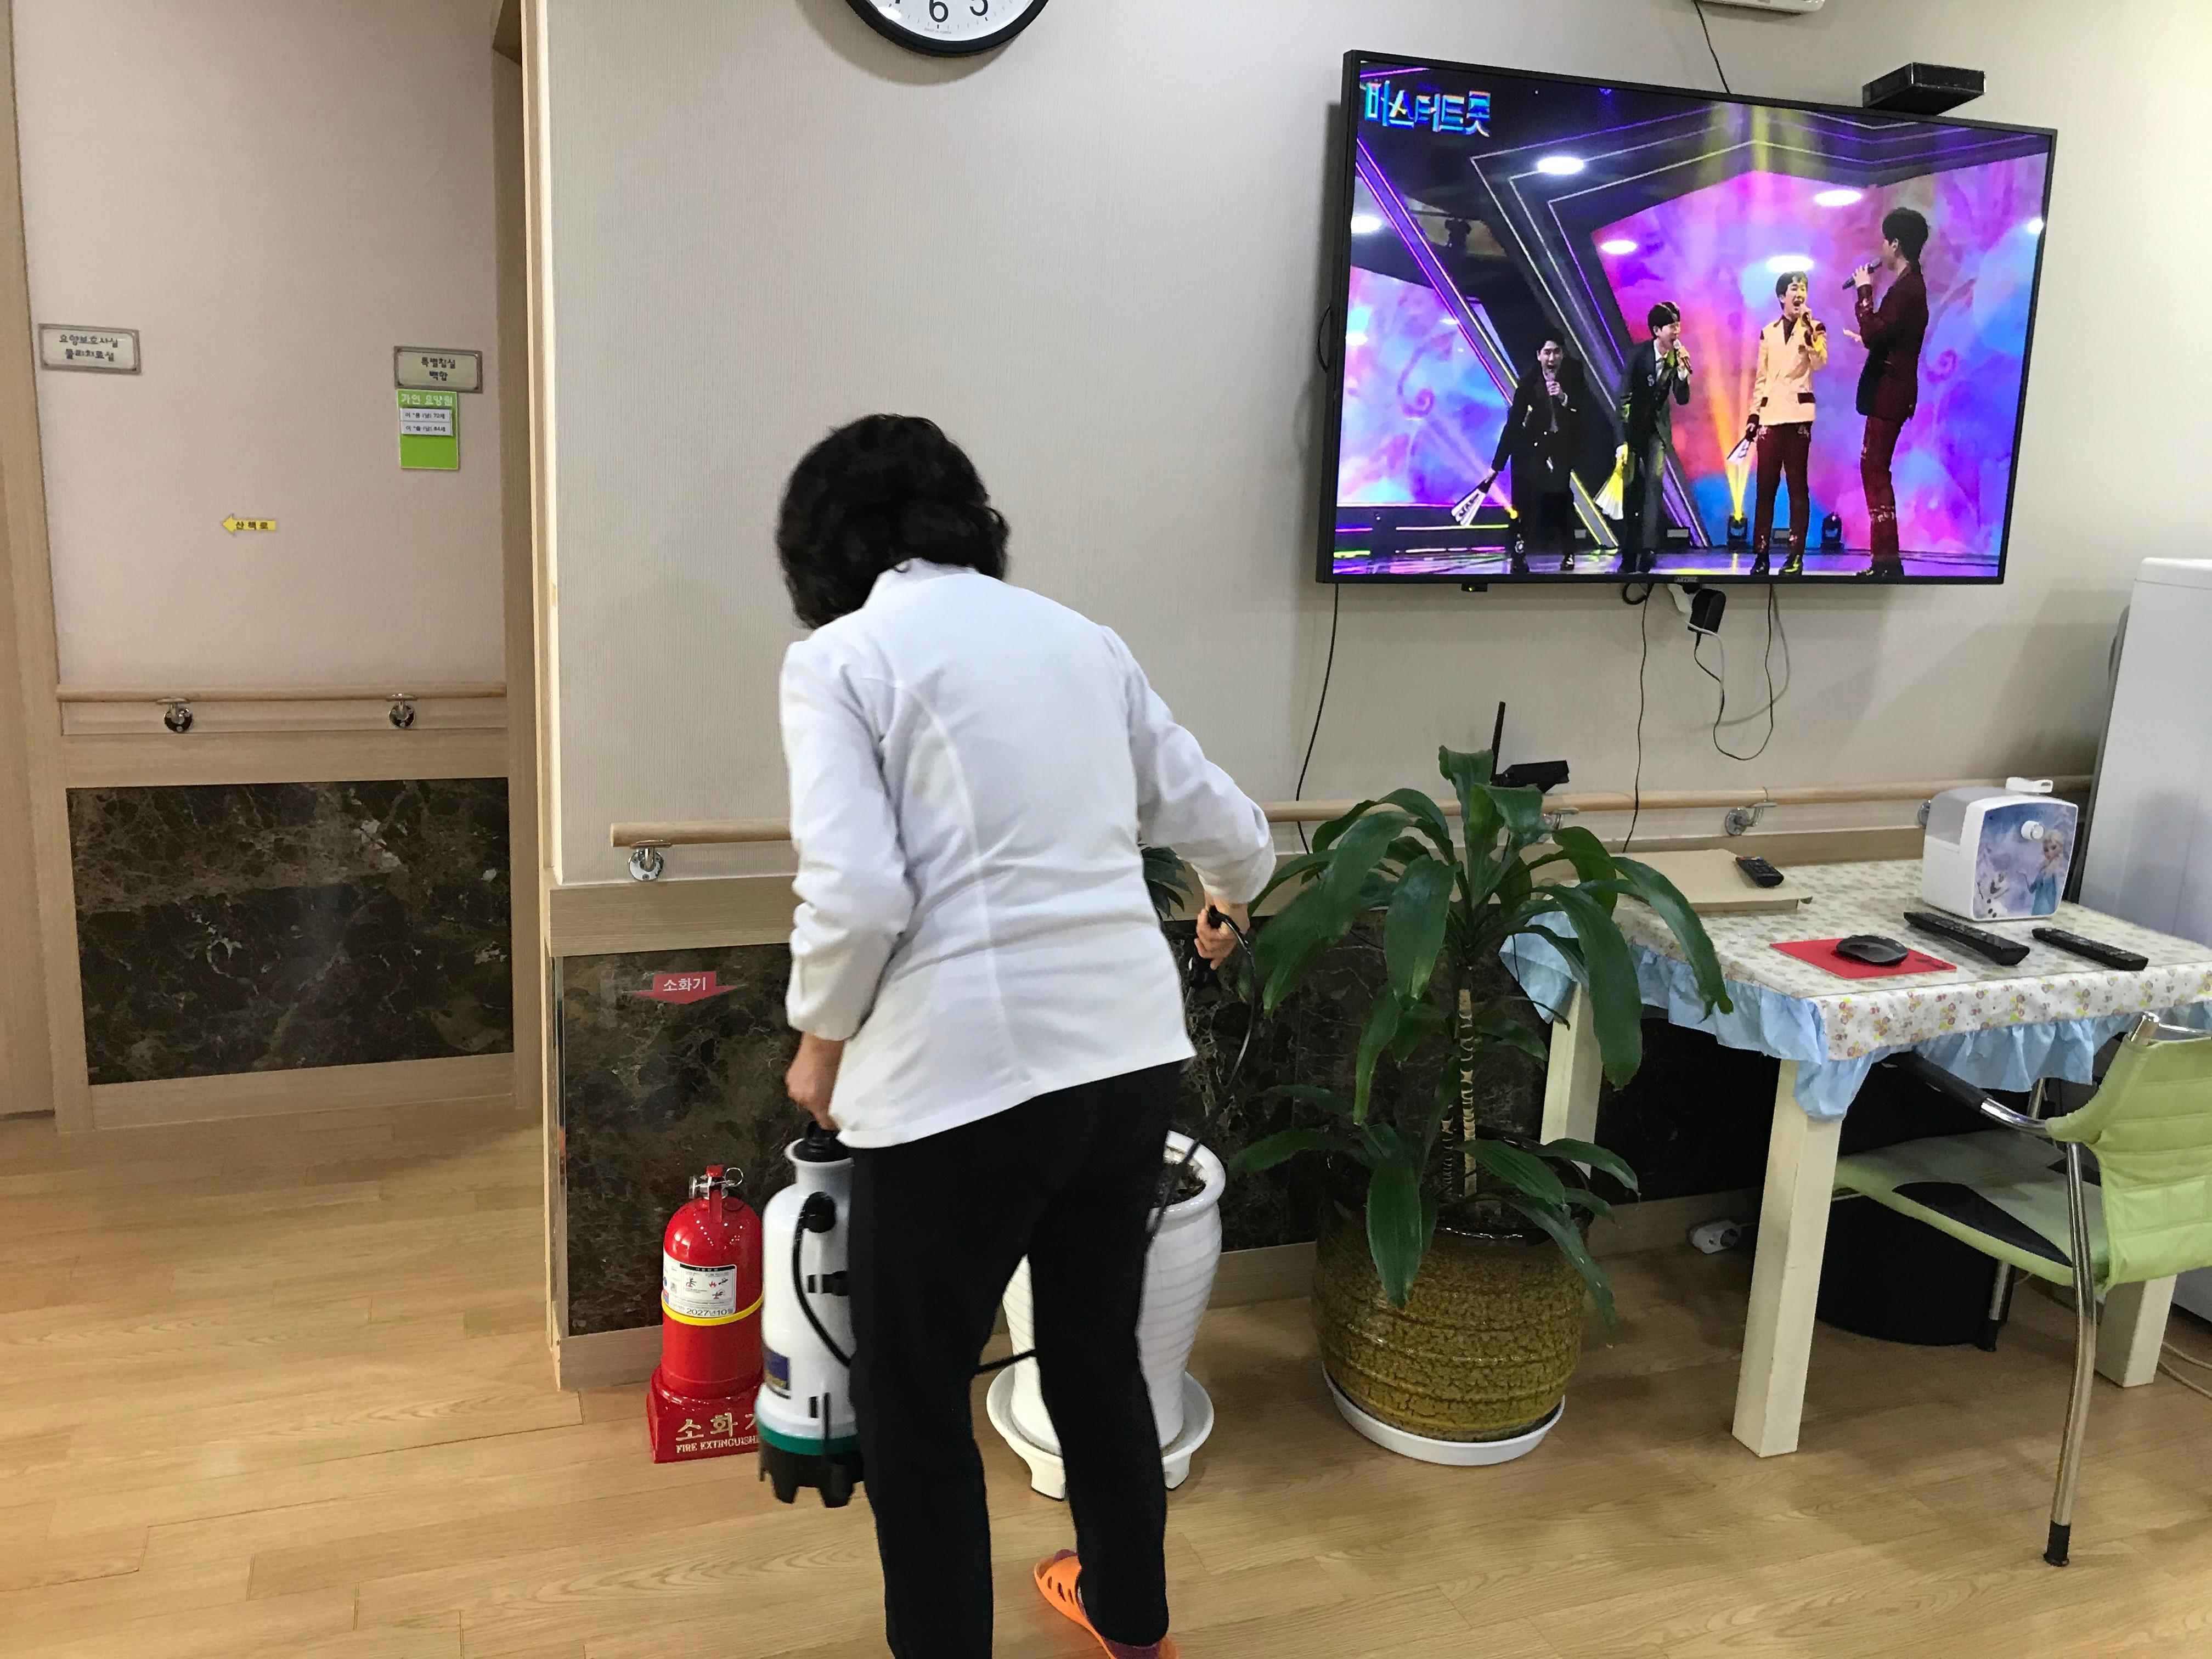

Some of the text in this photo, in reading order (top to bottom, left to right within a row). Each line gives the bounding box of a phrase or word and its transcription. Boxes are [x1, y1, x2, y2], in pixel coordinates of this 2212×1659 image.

[929, 0, 949, 22] 6
[1365, 80, 1491, 137] 미스터트롯
[59, 334, 119, 348] 요양보호사실
[424, 394, 453, 407] 요양원
[663, 977, 707, 991] 소화기
[676, 1434, 760, 1453] FIRE EXTINGUISH
